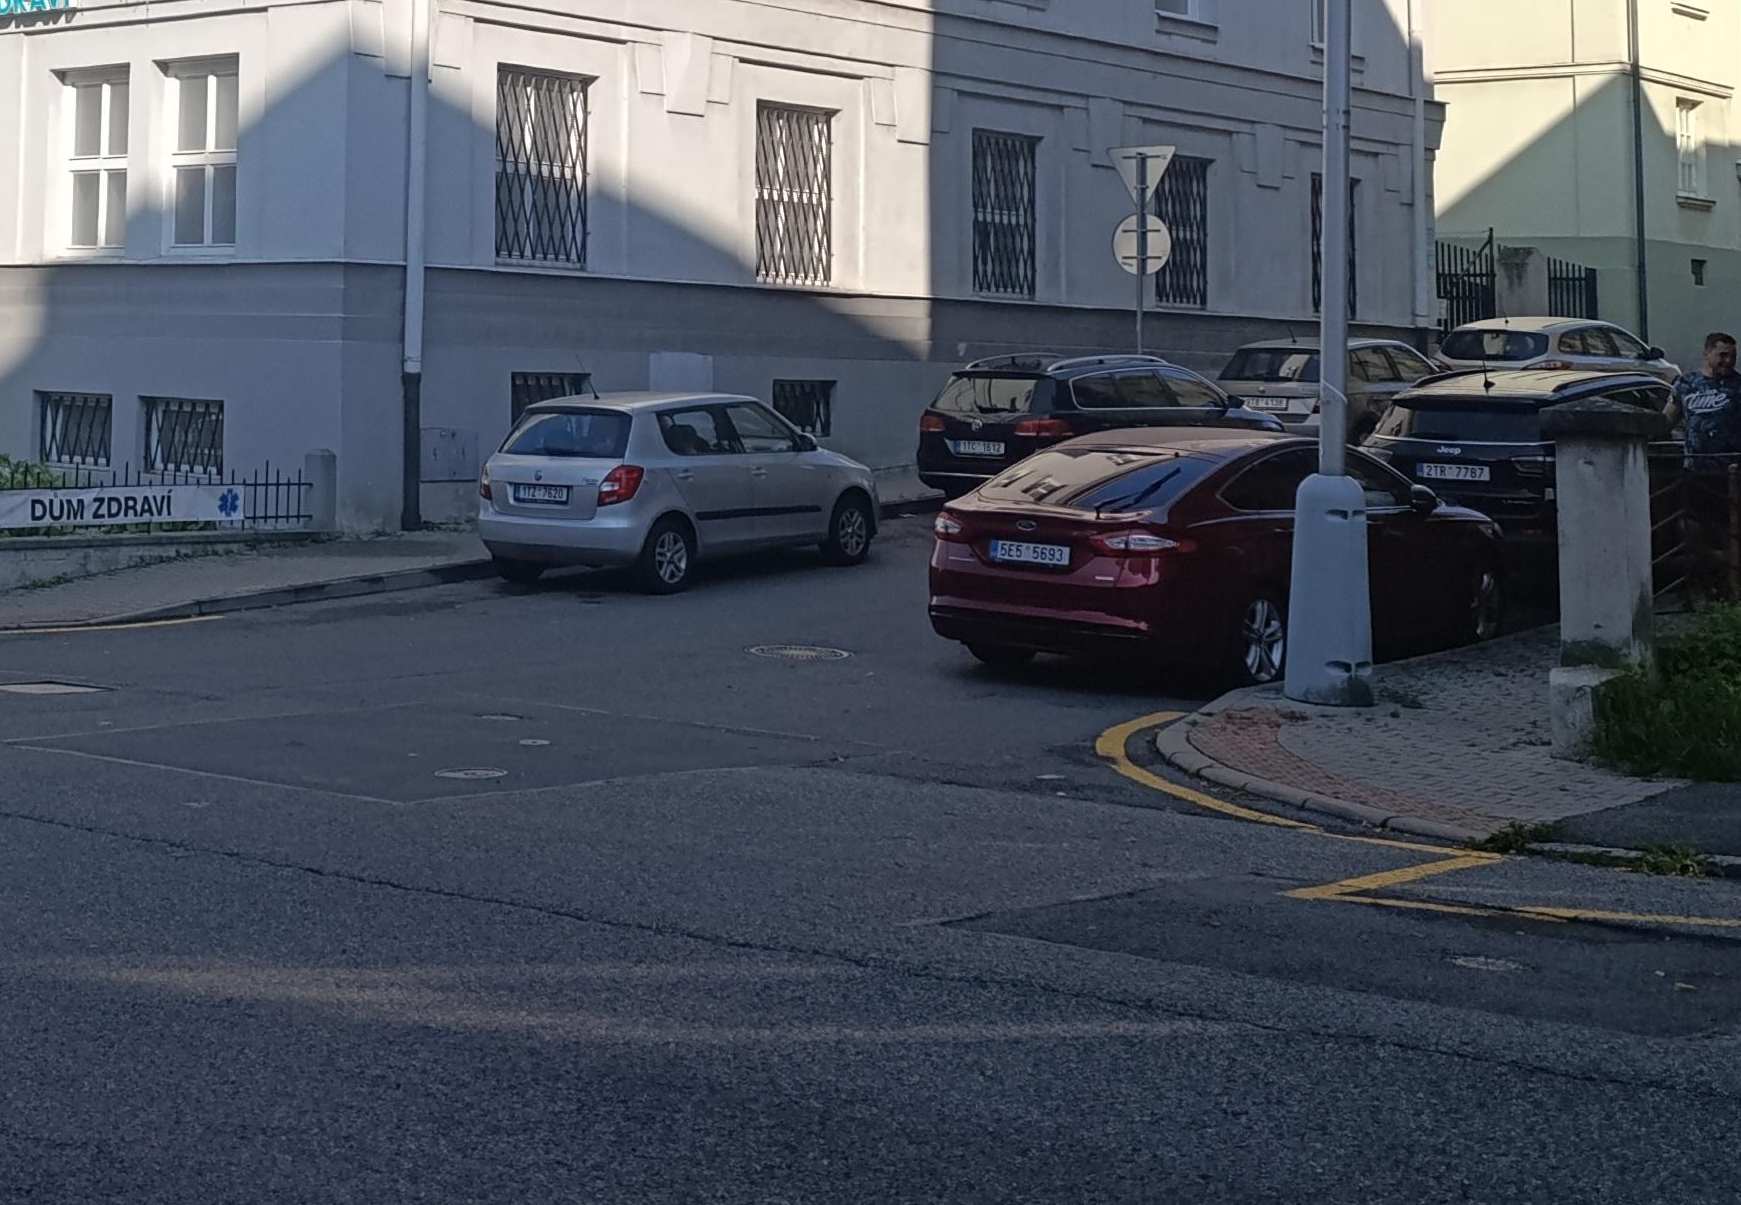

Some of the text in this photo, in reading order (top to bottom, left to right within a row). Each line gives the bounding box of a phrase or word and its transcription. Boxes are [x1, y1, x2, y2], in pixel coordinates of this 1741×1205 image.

[1436, 446, 1462, 455] Jeep
[1426, 465, 1485, 479] 2TR 7787
[30, 489, 173, 522] DŮM ZDRAVÍ
[1000, 543, 1064, 562] 5E5 5693
